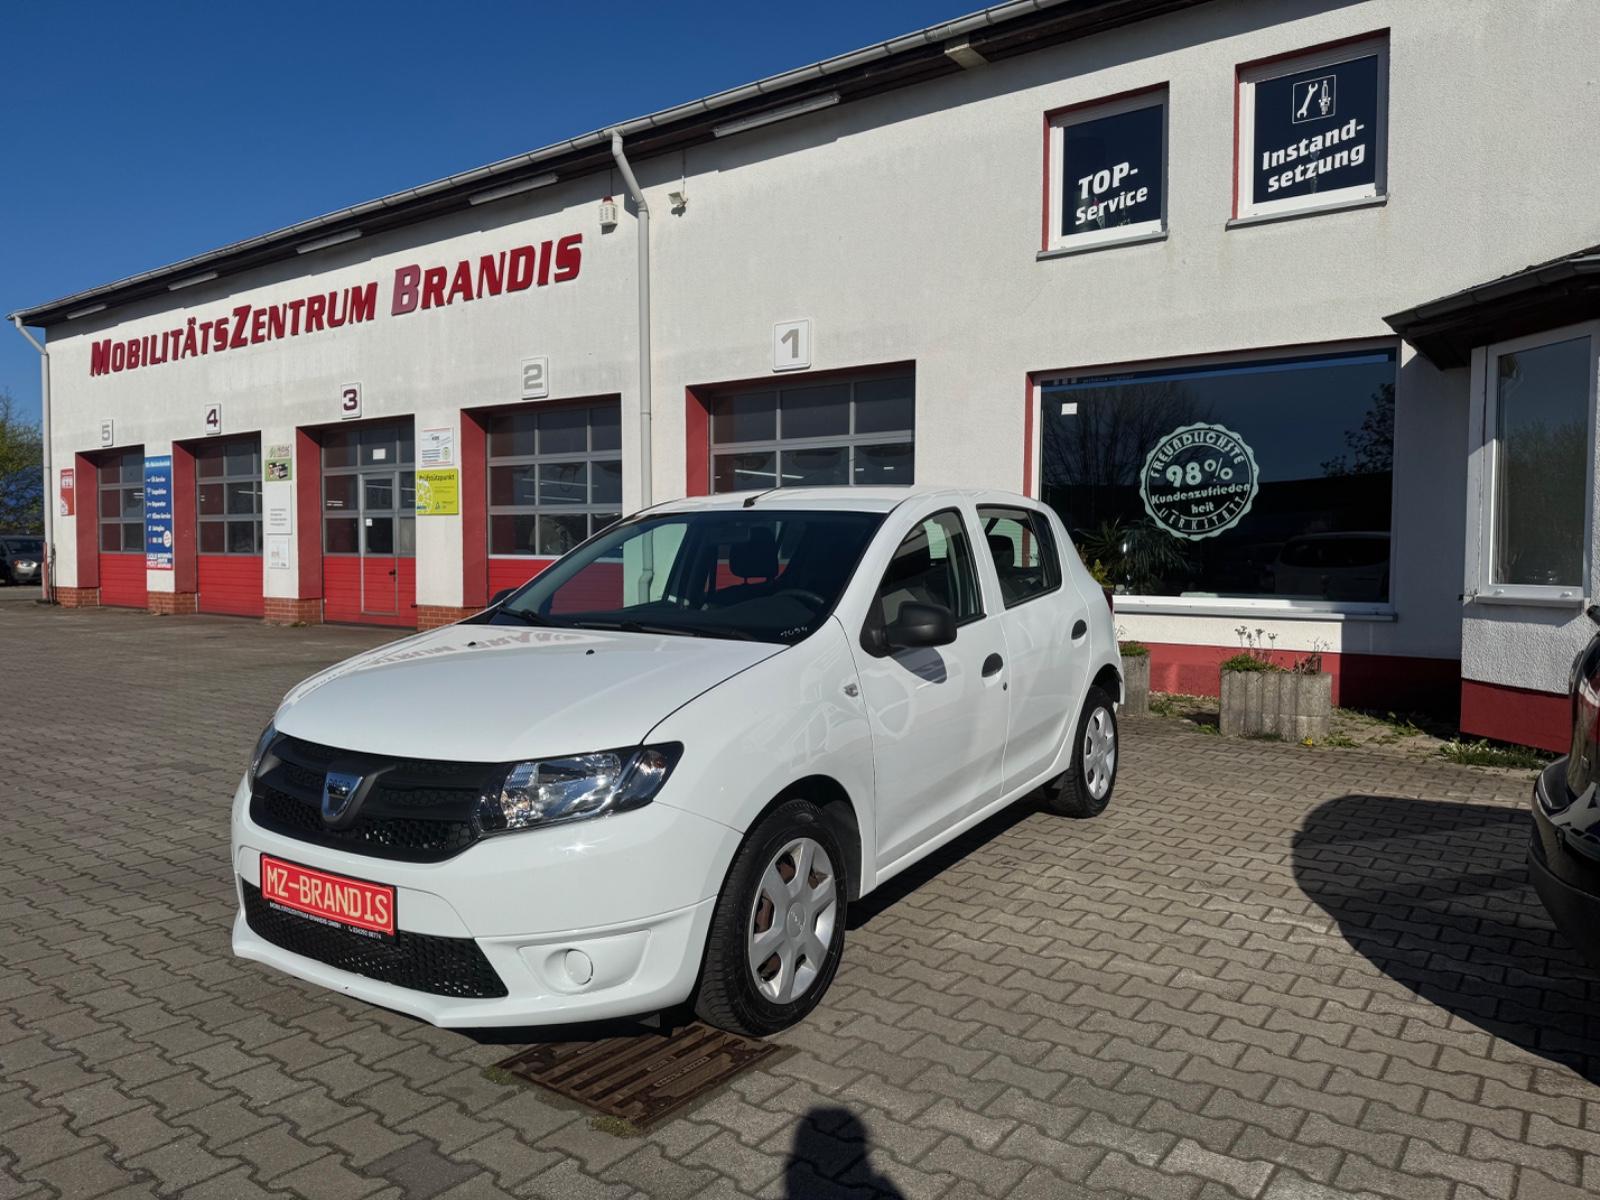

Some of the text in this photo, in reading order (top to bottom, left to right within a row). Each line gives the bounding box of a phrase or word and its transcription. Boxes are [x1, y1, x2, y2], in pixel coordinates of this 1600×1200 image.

[1262, 119, 1365, 170] Instand-
[1078, 161, 1138, 200] TOP-
[1268, 144, 1365, 192] setzung
[391, 233, 583, 316] BRANDIS
[780, 327, 800, 359] 1
[523, 363, 543, 390] 2
[343, 388, 358, 411] 3
[101, 424, 110, 441] 5
[206, 408, 218, 428] 4
[1150, 431, 1245, 478] FREUNDLICHSTE
[1150, 483, 1250, 505] Kundenzufrieden
[1191, 502, 1215, 514] heit
[266, 865, 388, 924] MZ-BRANDIS
